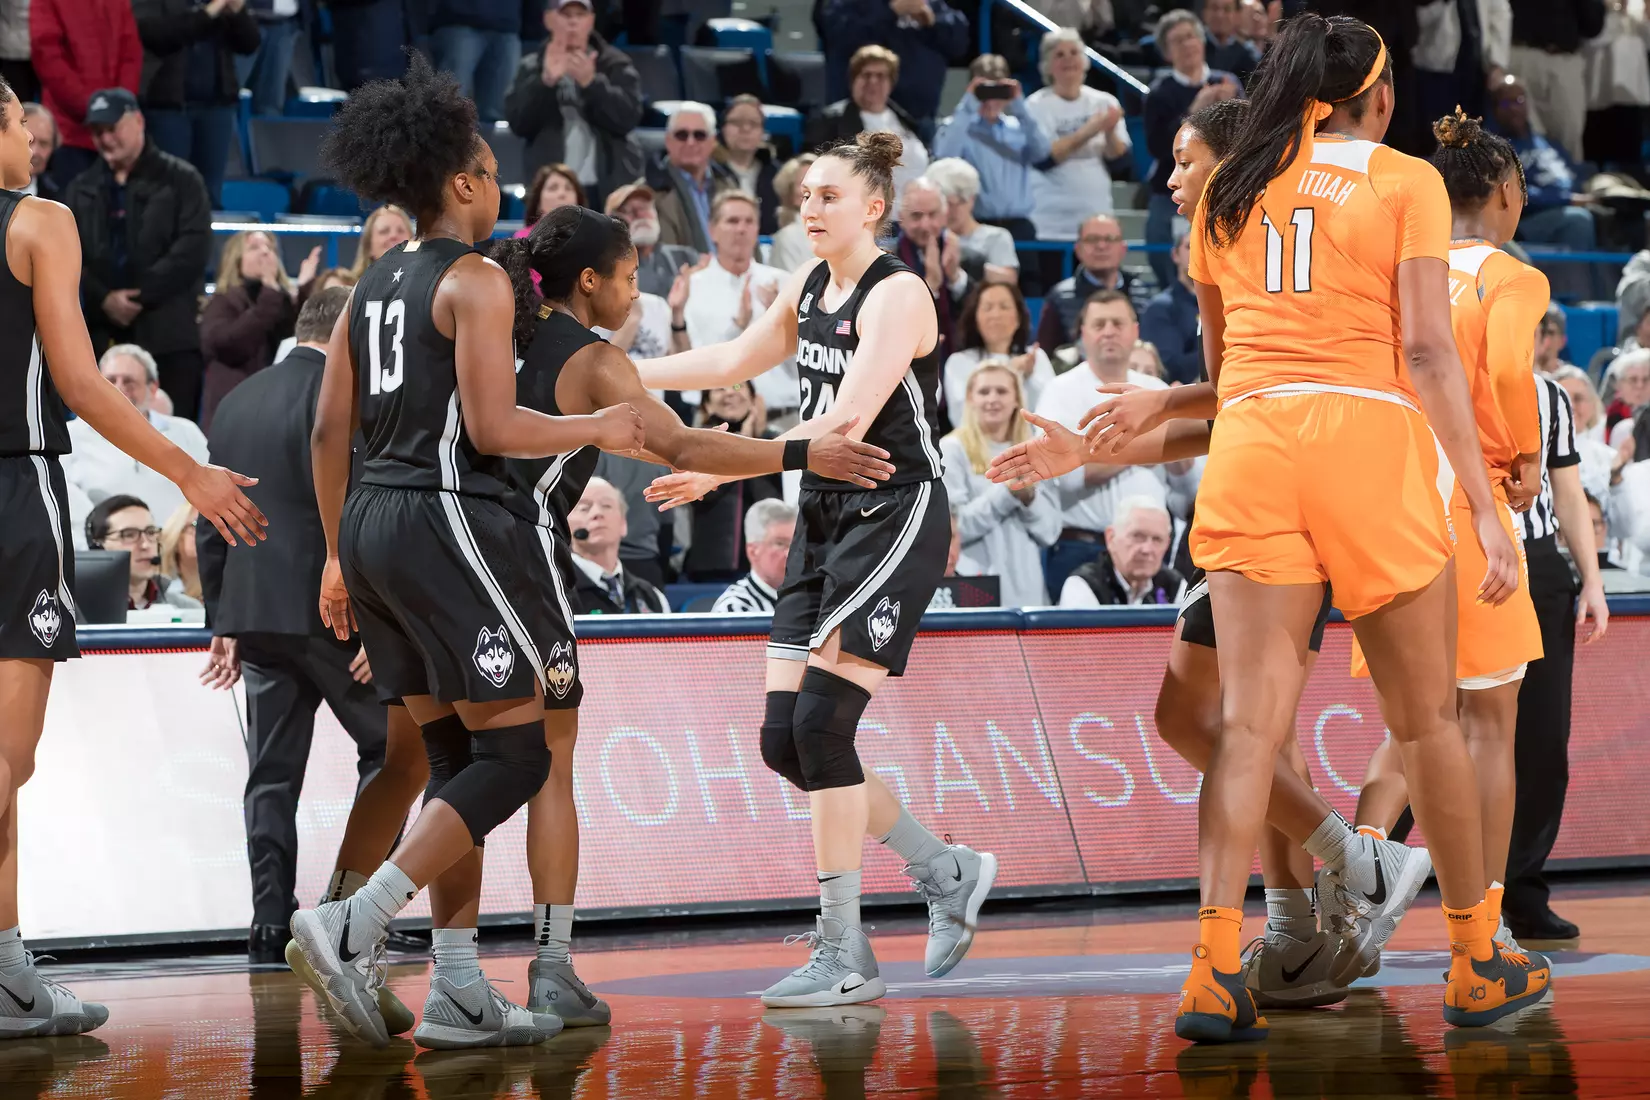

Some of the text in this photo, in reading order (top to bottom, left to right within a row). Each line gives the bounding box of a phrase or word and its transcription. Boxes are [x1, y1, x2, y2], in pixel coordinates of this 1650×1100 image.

[1297, 169, 1357, 206] ITUAH
[1261, 206, 1314, 293] 11
[365, 299, 405, 396] 13
[1448, 913, 1473, 921] GRIP
